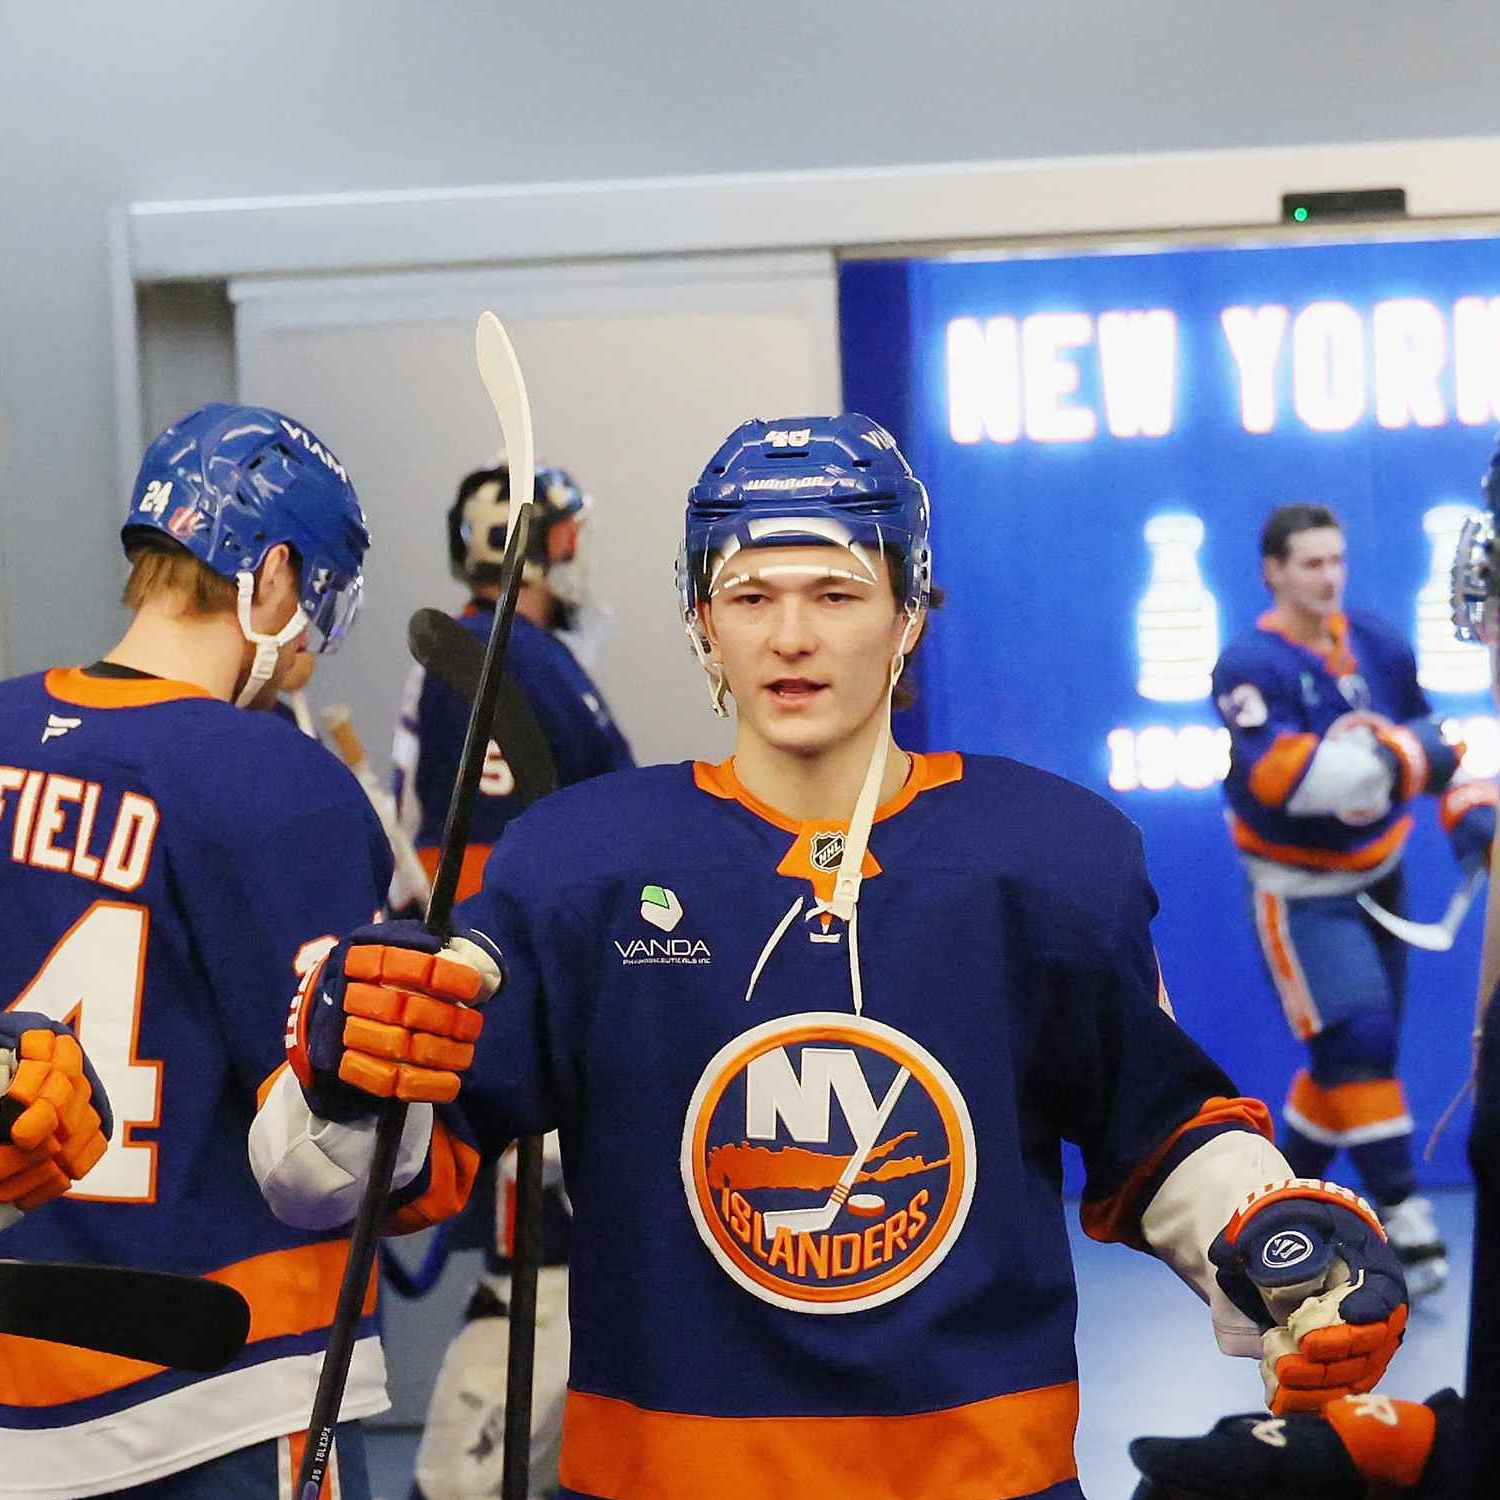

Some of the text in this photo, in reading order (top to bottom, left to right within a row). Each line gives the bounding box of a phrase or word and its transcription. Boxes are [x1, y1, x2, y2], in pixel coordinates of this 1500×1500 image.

[946, 306, 1178, 444] NEW
[139, 480, 173, 512] 24
[614, 938, 711, 958] VANDA
[747, 1046, 910, 1148] NY
[721, 1187, 929, 1279] ISLANDERS
